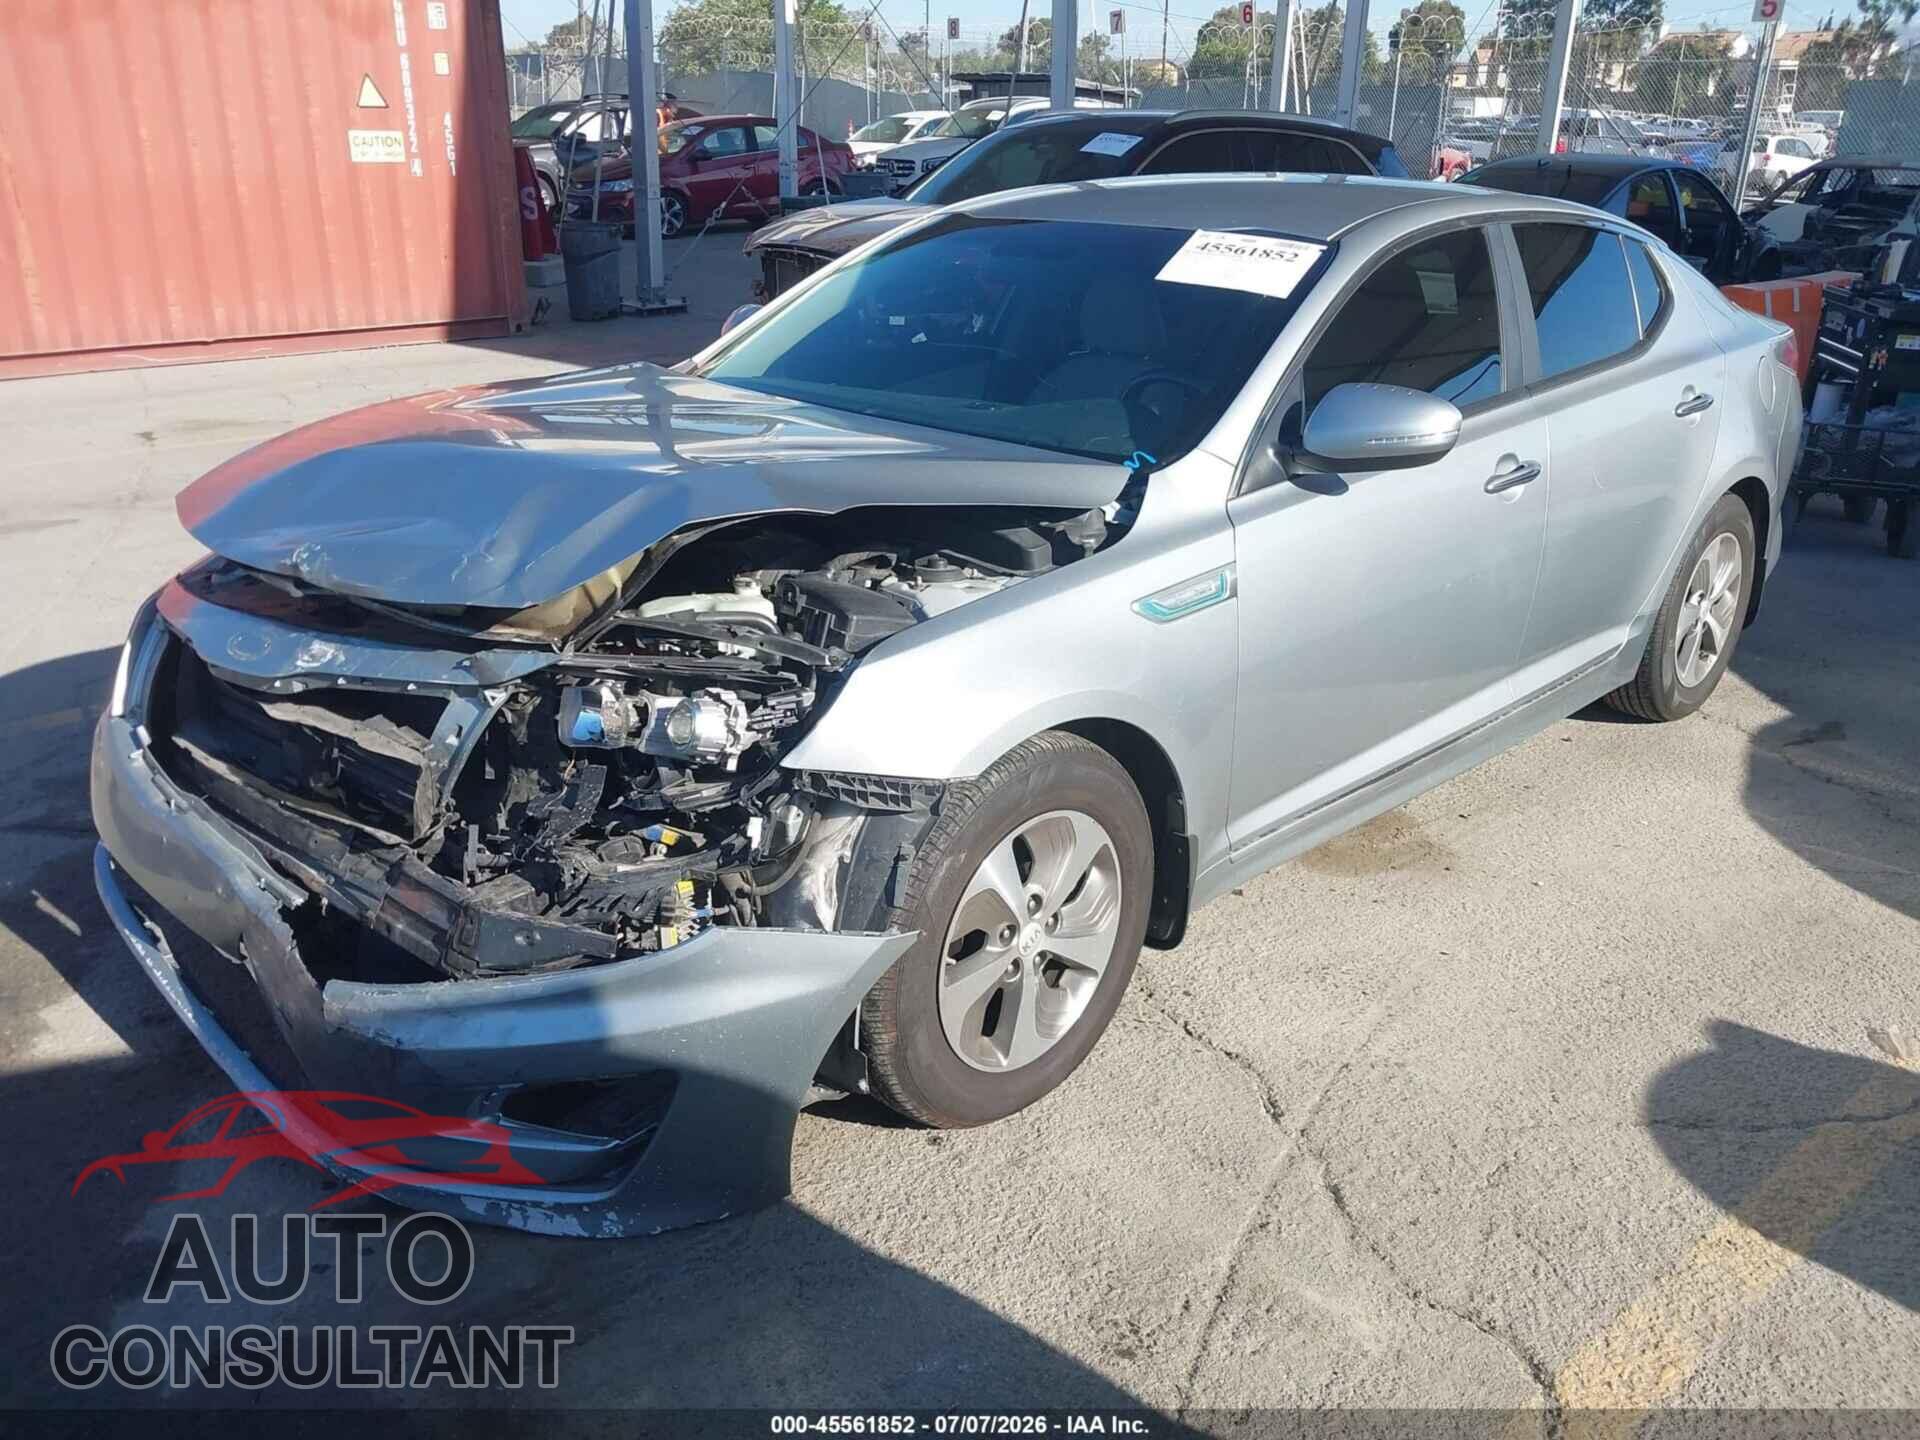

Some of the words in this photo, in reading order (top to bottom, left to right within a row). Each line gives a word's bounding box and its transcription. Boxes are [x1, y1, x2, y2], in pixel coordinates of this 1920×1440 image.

[1243, 5, 1253, 23] 6
[1761, 0, 1777, 17] 5
[950, 21, 957, 37] 8
[1111, 12, 1122, 31] 7
[352, 135, 402, 148] CAUTION
[443, 112, 456, 176] 45G1
[1197, 240, 1300, 263] 45561852
